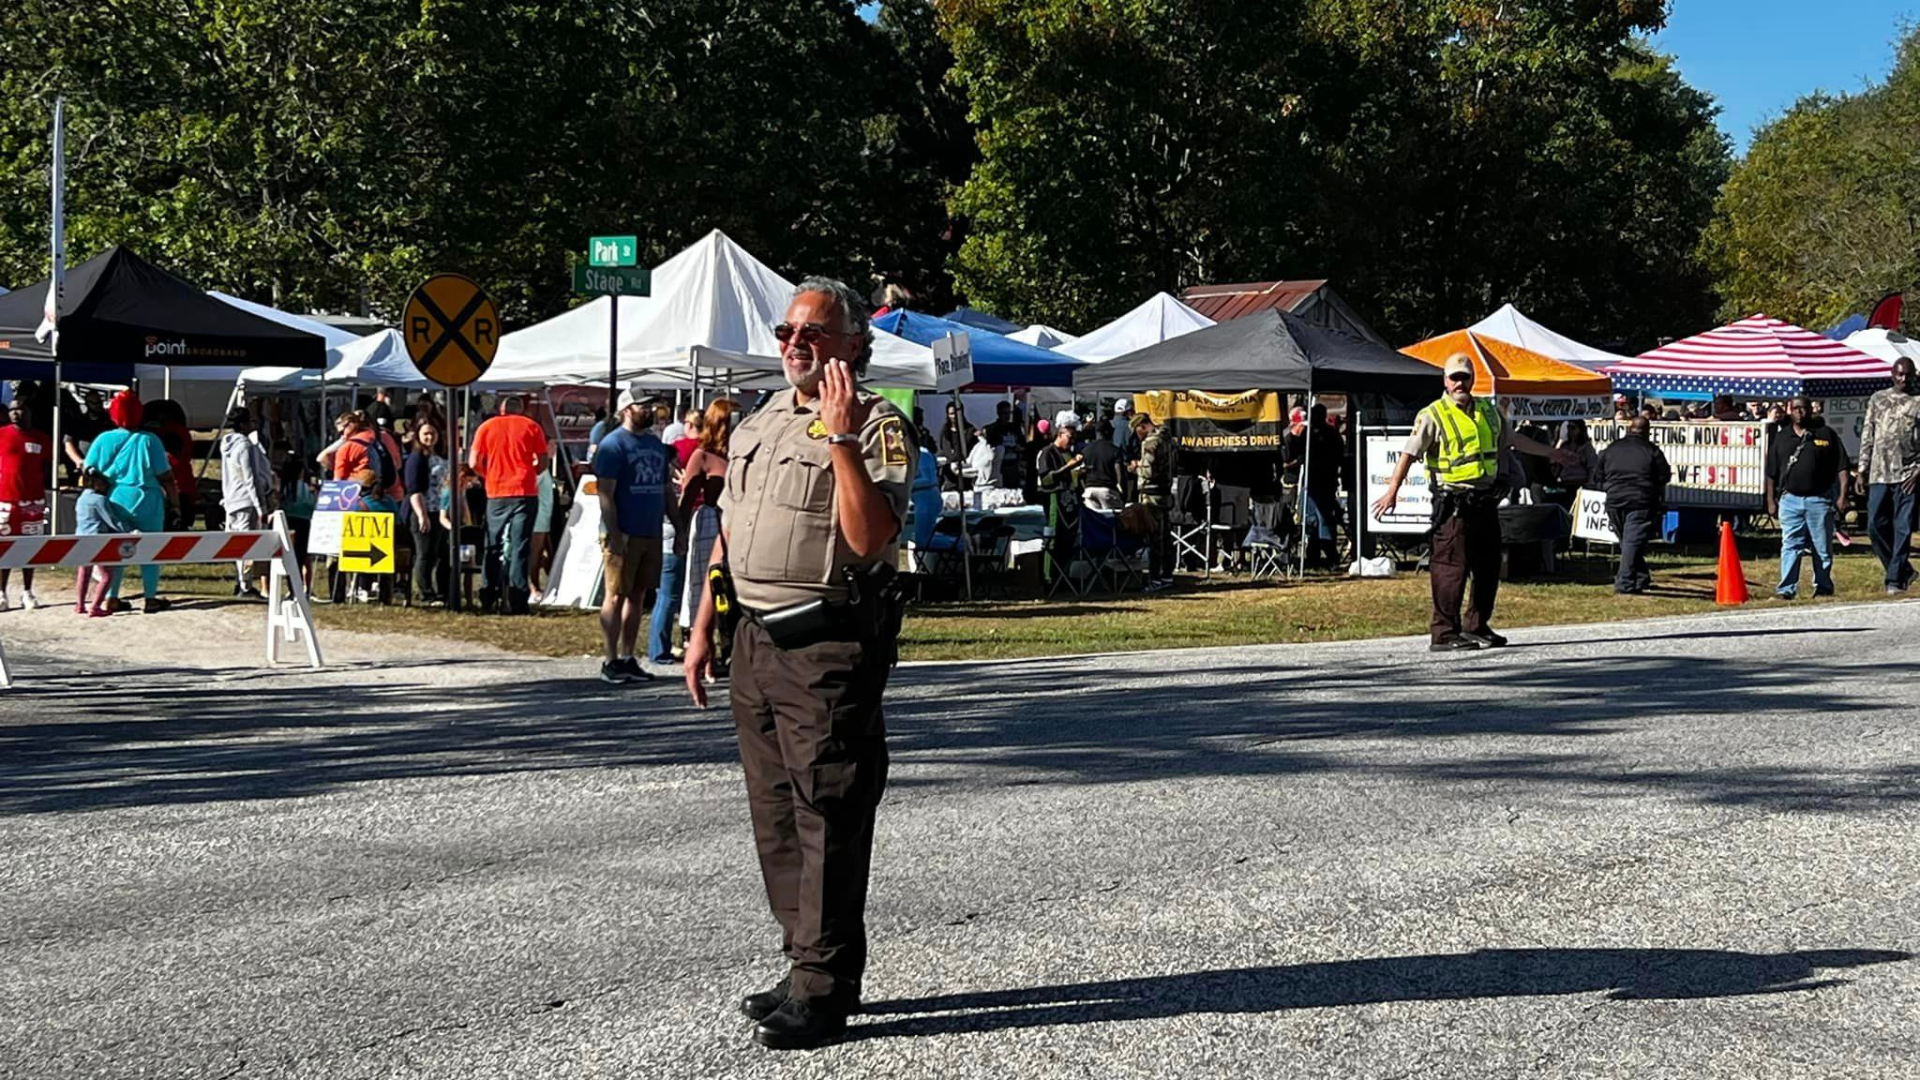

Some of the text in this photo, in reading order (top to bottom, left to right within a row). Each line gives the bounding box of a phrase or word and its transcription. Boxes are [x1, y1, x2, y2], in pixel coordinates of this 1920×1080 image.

[594, 240, 619, 262] Park
[585, 269, 624, 292] Stage
[412, 316, 493, 345] R R
[145, 338, 187, 358] point
[1181, 435, 1248, 447] AWARENESS
[1250, 434, 1280, 446] DRIVE
[1649, 426, 1686, 445] EETING
[342, 515, 391, 539] ATM
